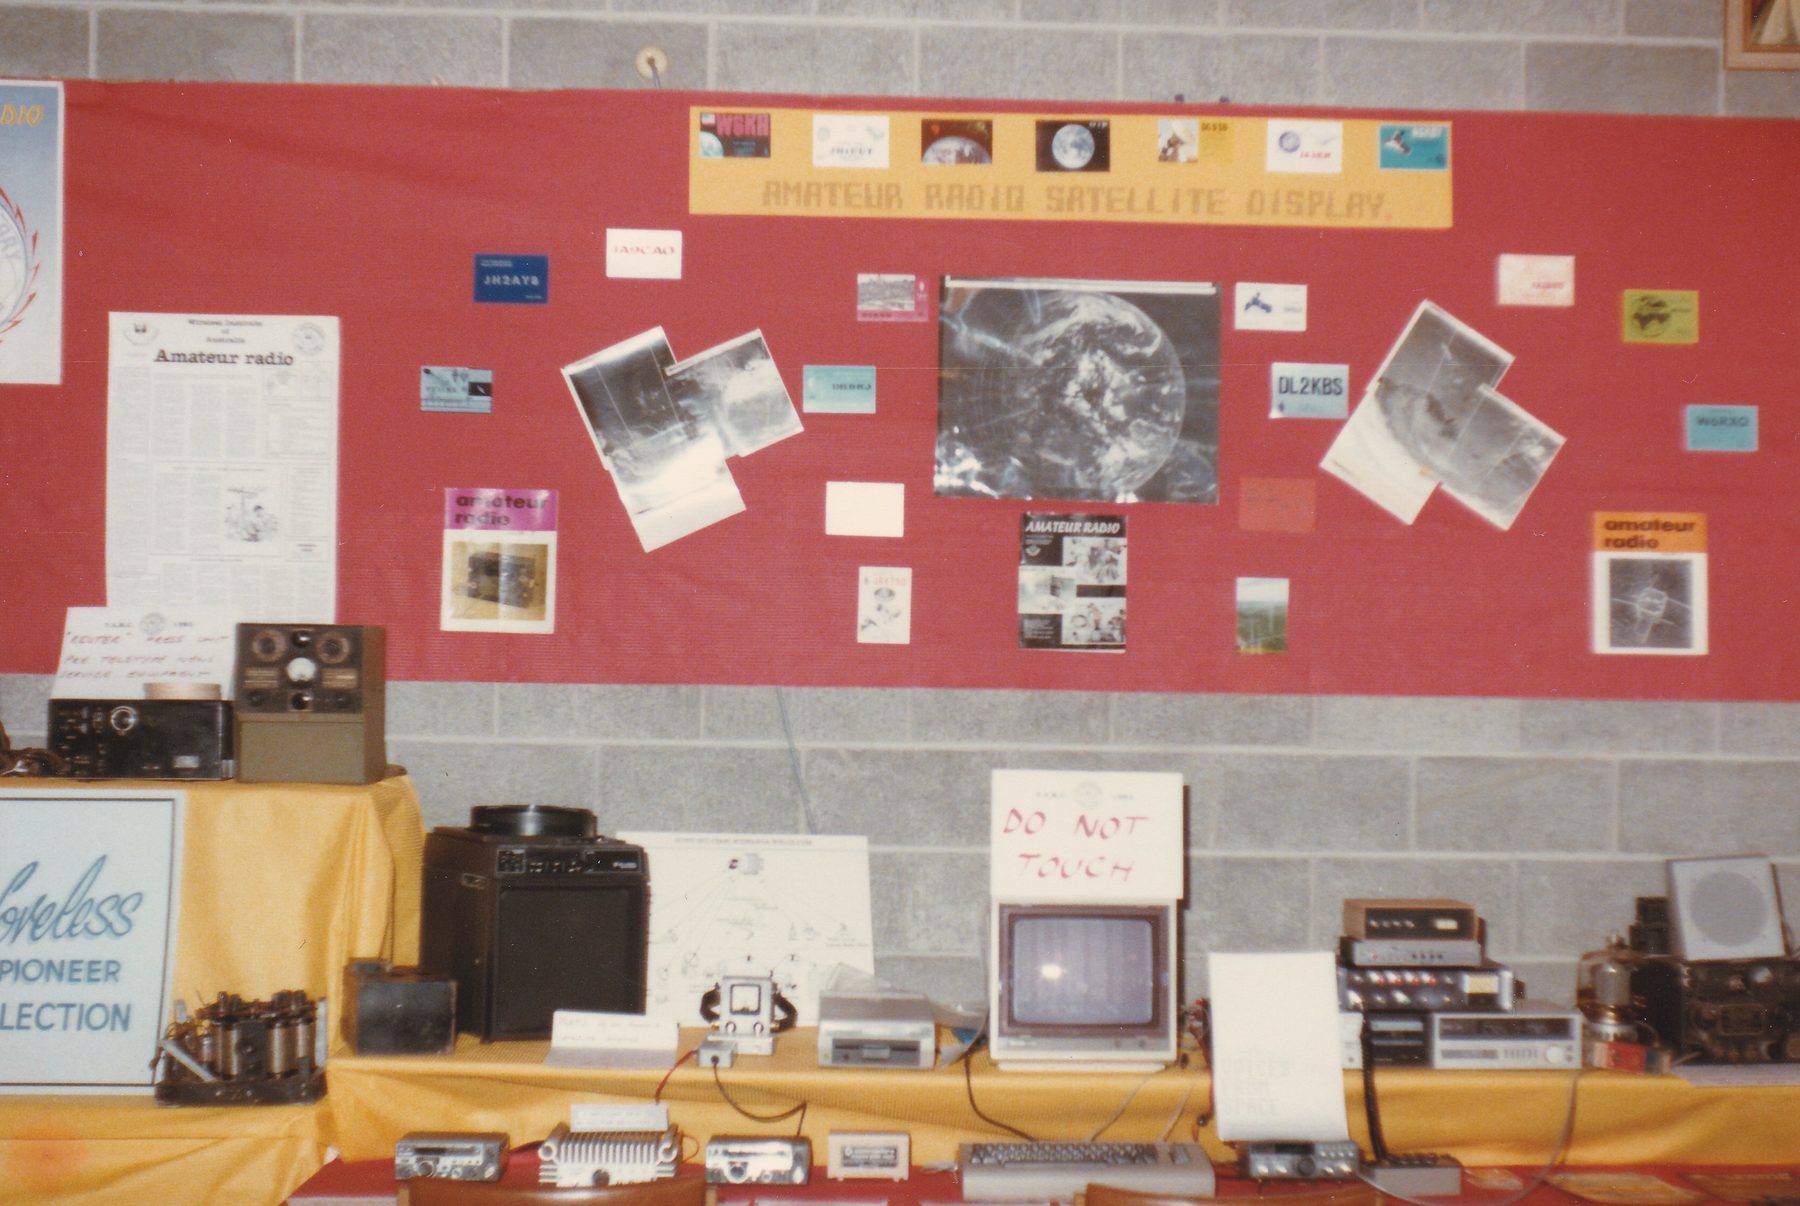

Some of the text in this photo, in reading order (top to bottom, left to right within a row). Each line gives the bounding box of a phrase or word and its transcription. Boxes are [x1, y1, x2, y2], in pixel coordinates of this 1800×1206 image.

[762, 181, 903, 209] AMATEUR
[925, 183, 1025, 212] RADIO
[1046, 185, 1226, 216] SATELLITE
[154, 348, 295, 366] Amateur radio
[1278, 376, 1343, 396] DL2KBS
[455, 495, 548, 509] amateur
[455, 512, 511, 526] radio
[1025, 520, 1121, 534] AMATEUR RADIO
[1604, 518, 1696, 532] amateur
[1604, 534, 1659, 549] radio
[1003, 808, 1150, 840] DO NOT
[1018, 853, 1136, 882] TOUCH
[0, 958, 122, 984] PIONEER
[0, 1002, 132, 1032] LECTION
